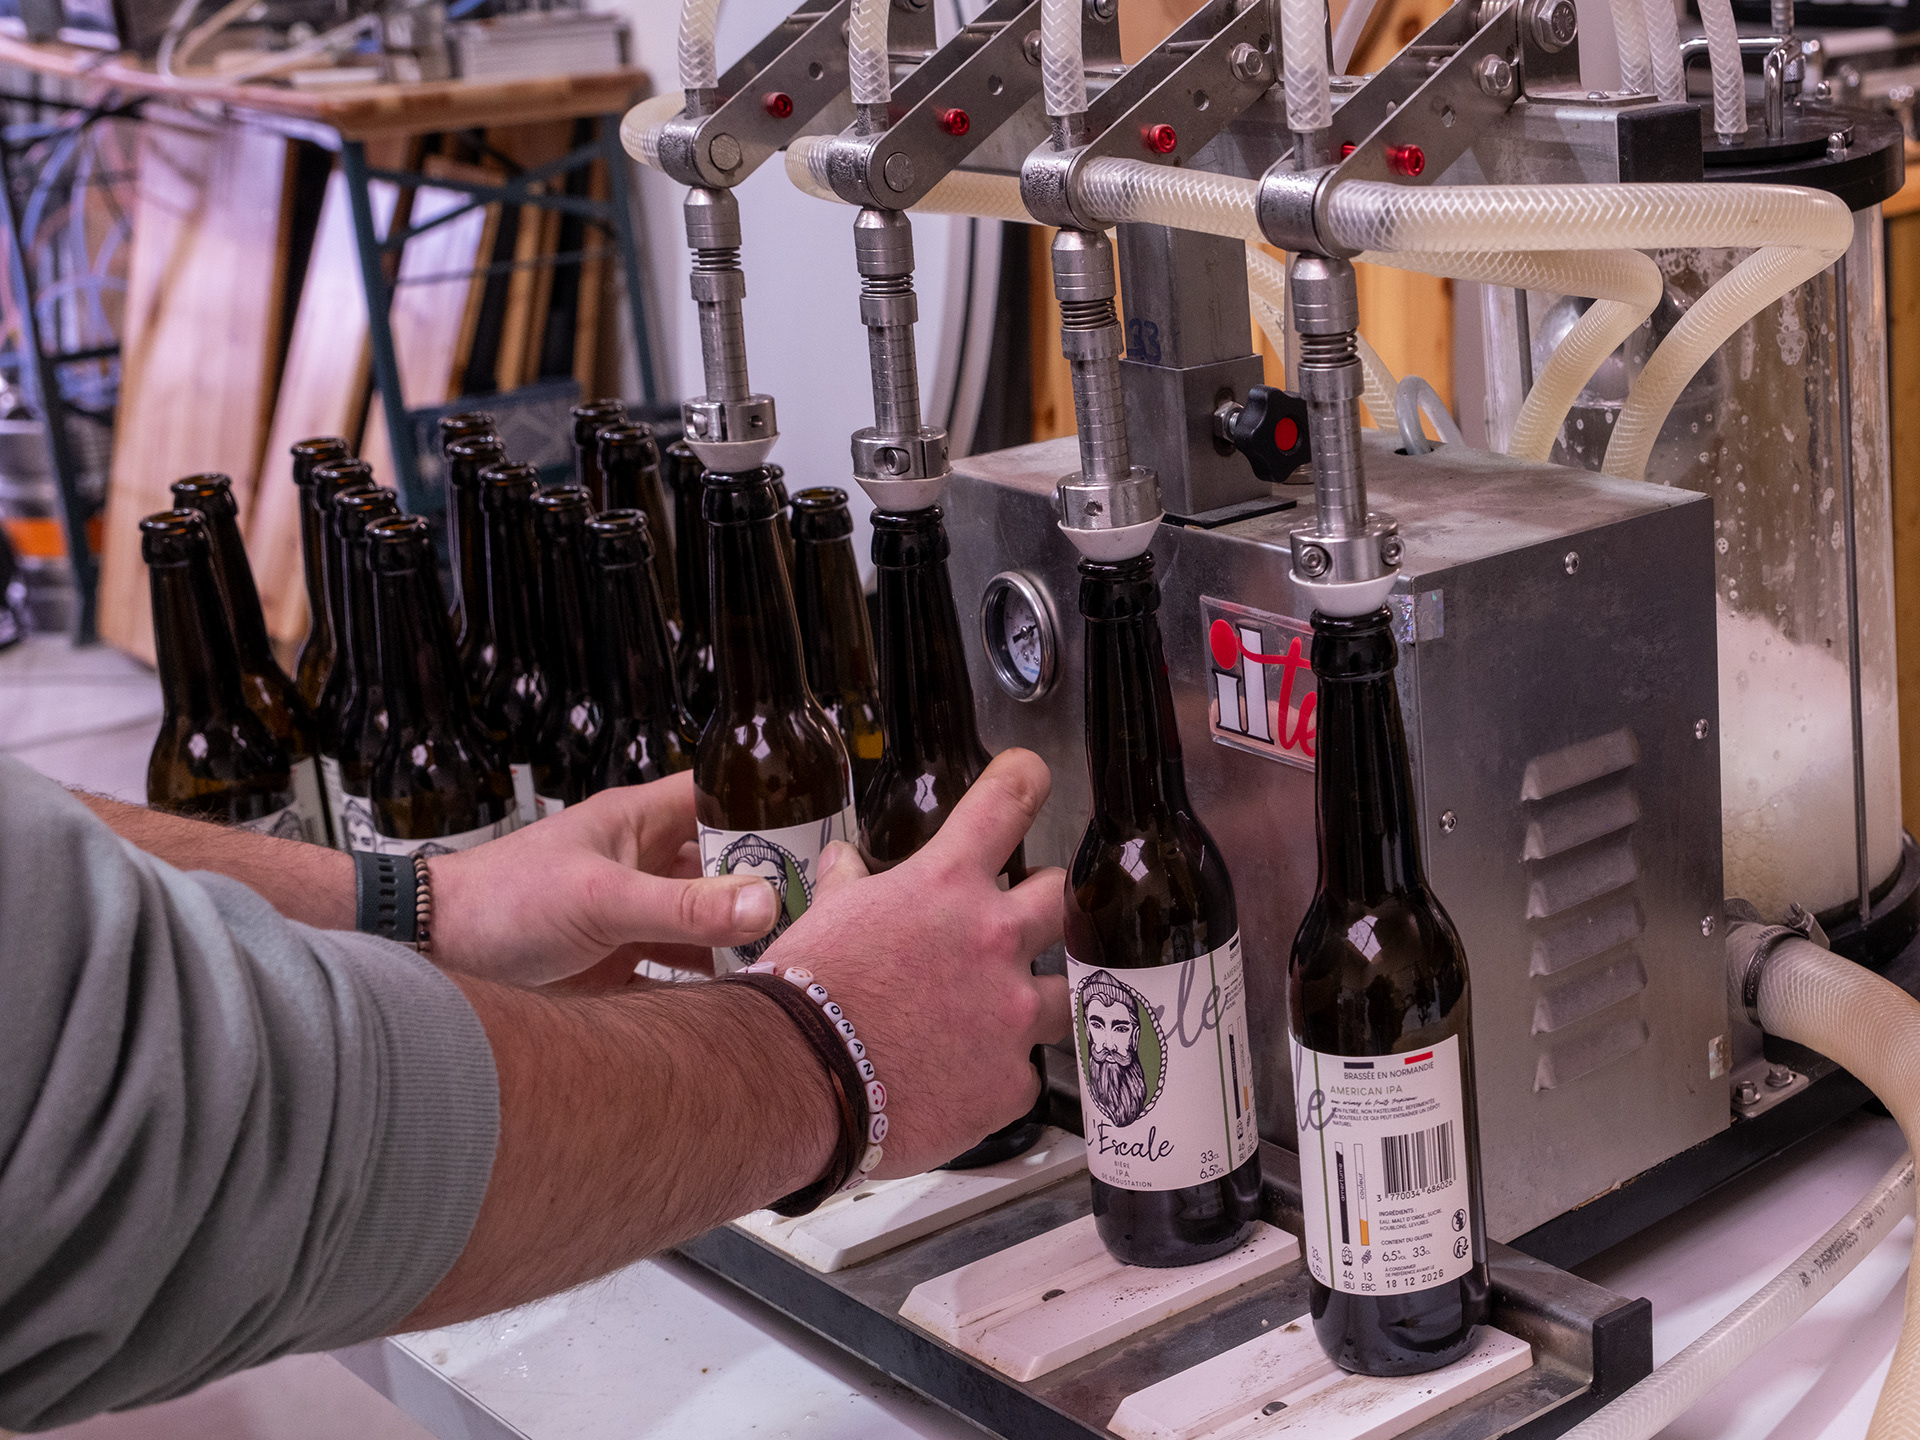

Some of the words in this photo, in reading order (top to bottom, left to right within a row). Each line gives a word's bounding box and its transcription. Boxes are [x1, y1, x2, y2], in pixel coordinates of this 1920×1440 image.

[814, 986, 875, 1076] RONAN
[1344, 1071, 1375, 1080] BRASSÉE
[1377, 1072, 1388, 1080] EN
[1390, 1061, 1434, 1078] NORMANDIE
[1330, 1085, 1382, 1096] AMERICAN
[1386, 1085, 1403, 1094] IPA
[1380, 1112, 1392, 1120] PEUT
[1102, 1172, 1108, 1180] DE
[1116, 1169, 1130, 1178] IPA
[1338, 1163, 1346, 1201] amertume
[1376, 1194, 1382, 1202] 3
[1390, 1190, 1420, 1201] 770034
[1426, 1178, 1453, 1195] 686026
[1381, 1238, 1405, 1246] CONTIENT
[1414, 1233, 1433, 1241] GLUTEN
[1389, 1264, 1416, 1272] CONSOMMER
[1343, 1270, 1354, 1280] 46
[1364, 1271, 1373, 1281] 13
[1344, 1281, 1356, 1290] IBU
[1361, 1283, 1377, 1292] EBC
[1386, 1279, 1397, 1288] 18
[1404, 1277, 1416, 1286] 12
